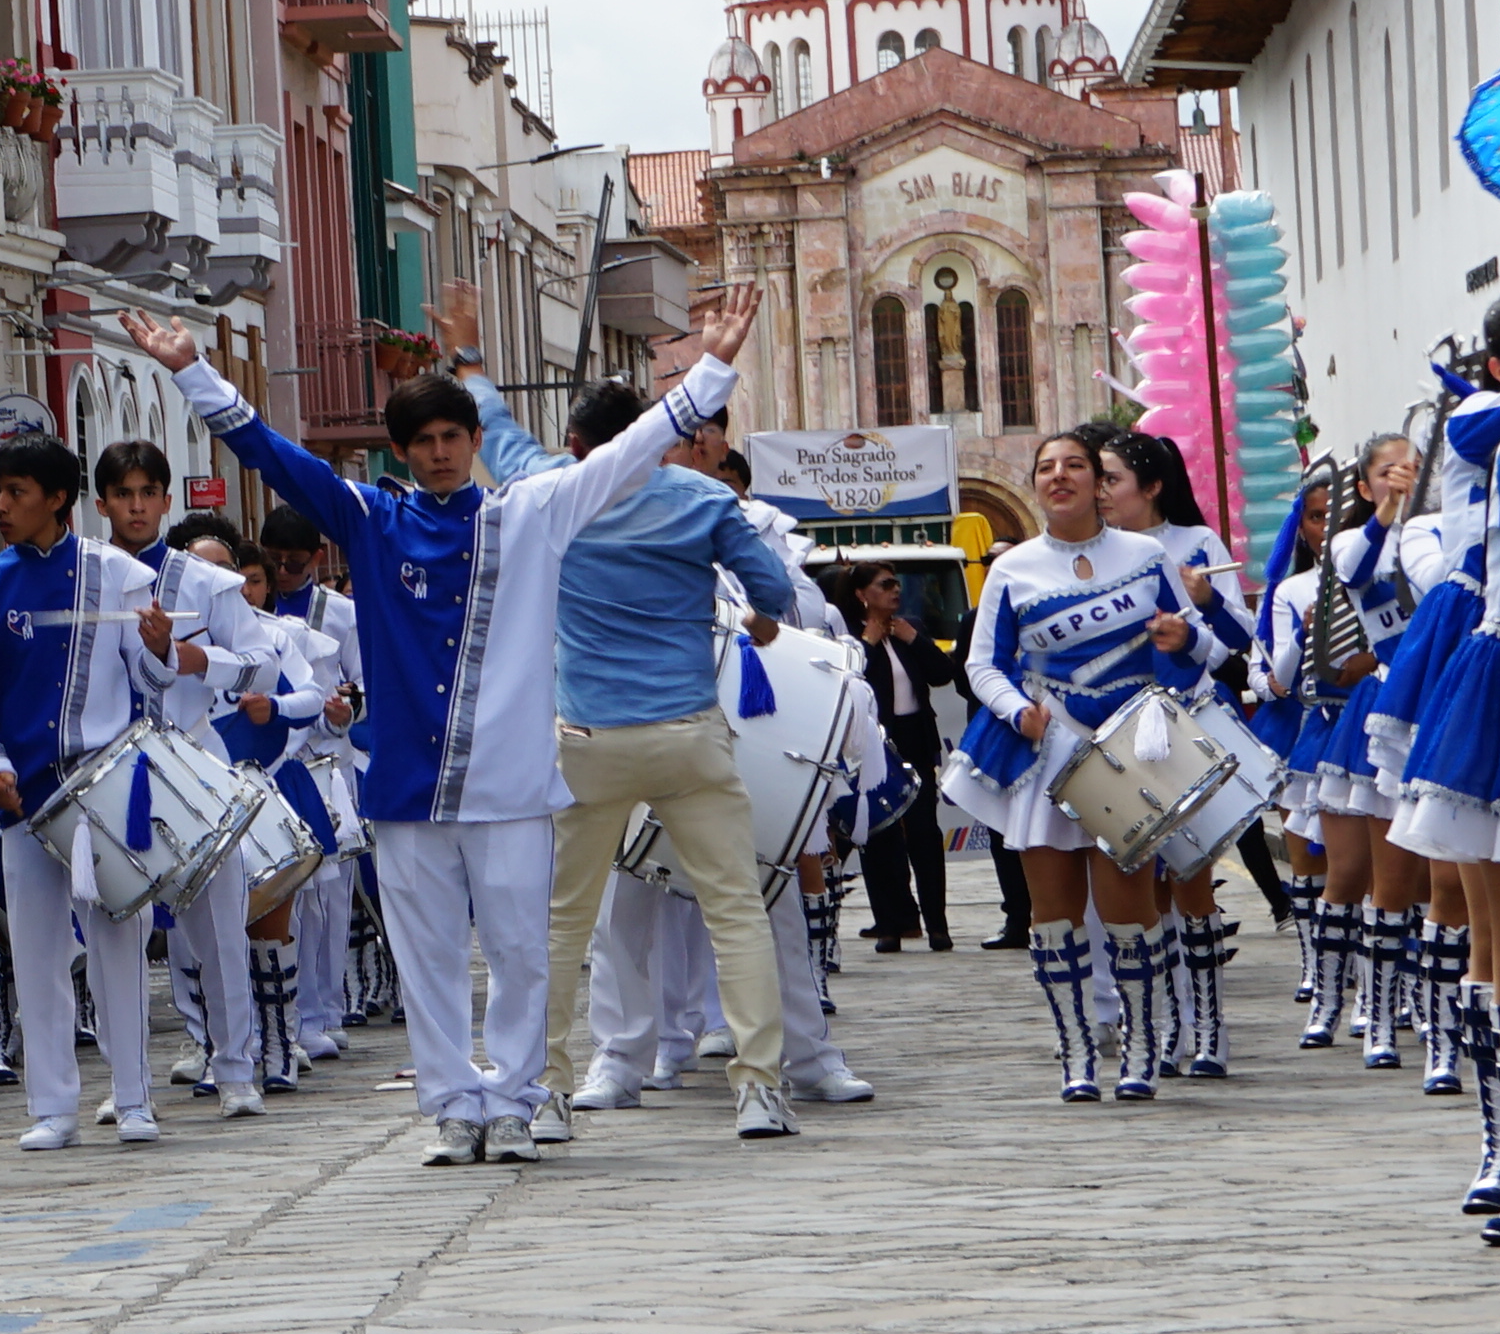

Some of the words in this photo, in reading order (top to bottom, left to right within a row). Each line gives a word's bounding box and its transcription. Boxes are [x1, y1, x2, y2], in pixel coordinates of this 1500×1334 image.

[898, 173, 936, 205] SAN
[952, 172, 1004, 203] BLAS
[796, 448, 827, 465] Pan
[831, 447, 896, 468] Sagrado
[777, 473, 797, 486] de
[833, 488, 881, 507] 1820
[1031, 593, 1137, 649] UEPCM
